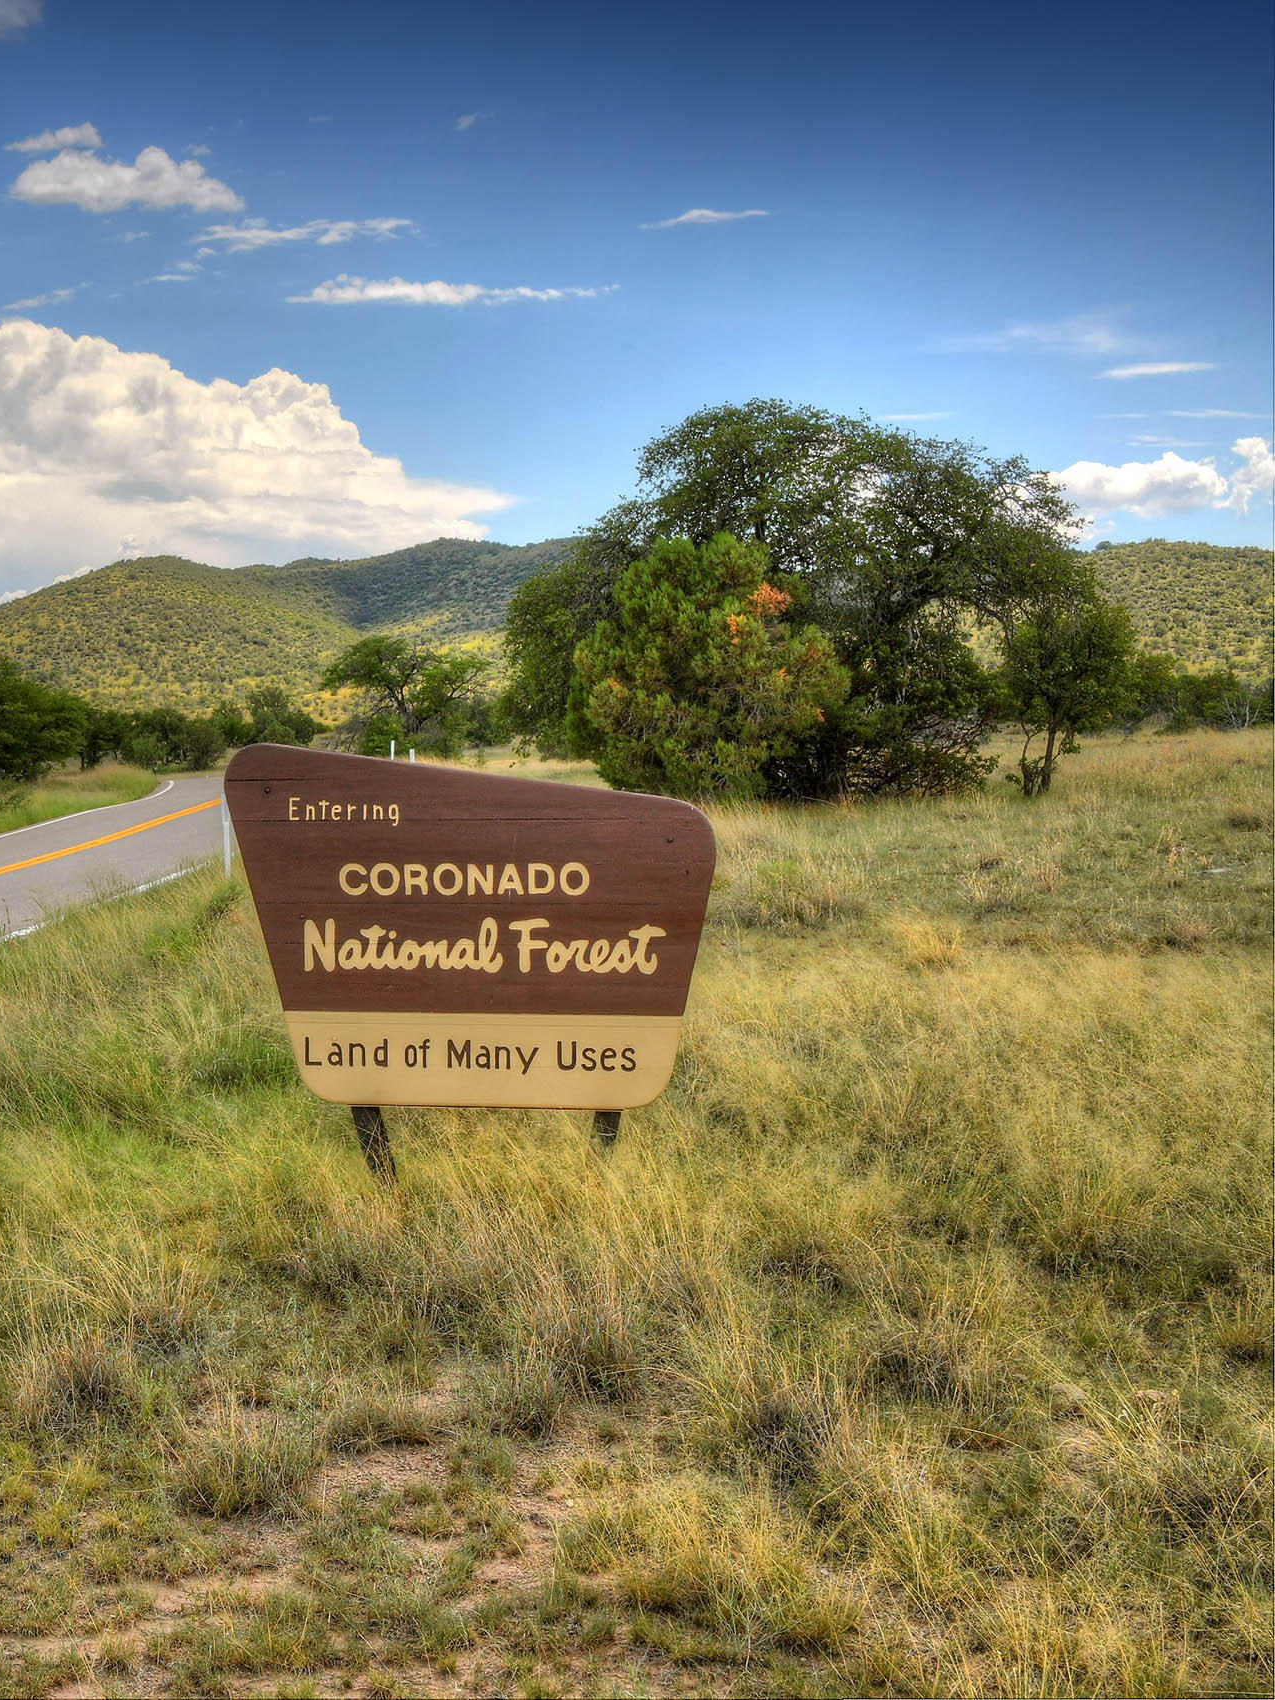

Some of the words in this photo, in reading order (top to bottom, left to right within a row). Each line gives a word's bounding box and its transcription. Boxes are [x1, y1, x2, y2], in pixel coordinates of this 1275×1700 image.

[288, 796, 400, 827] Entering
[338, 862, 591, 896] CORONADO
[303, 917, 503, 974] National
[508, 917, 667, 975] Forest
[304, 1036, 389, 1068] Land
[404, 1038, 431, 1068] of
[446, 1038, 540, 1076] Many
[556, 1040, 637, 1073] Uses
